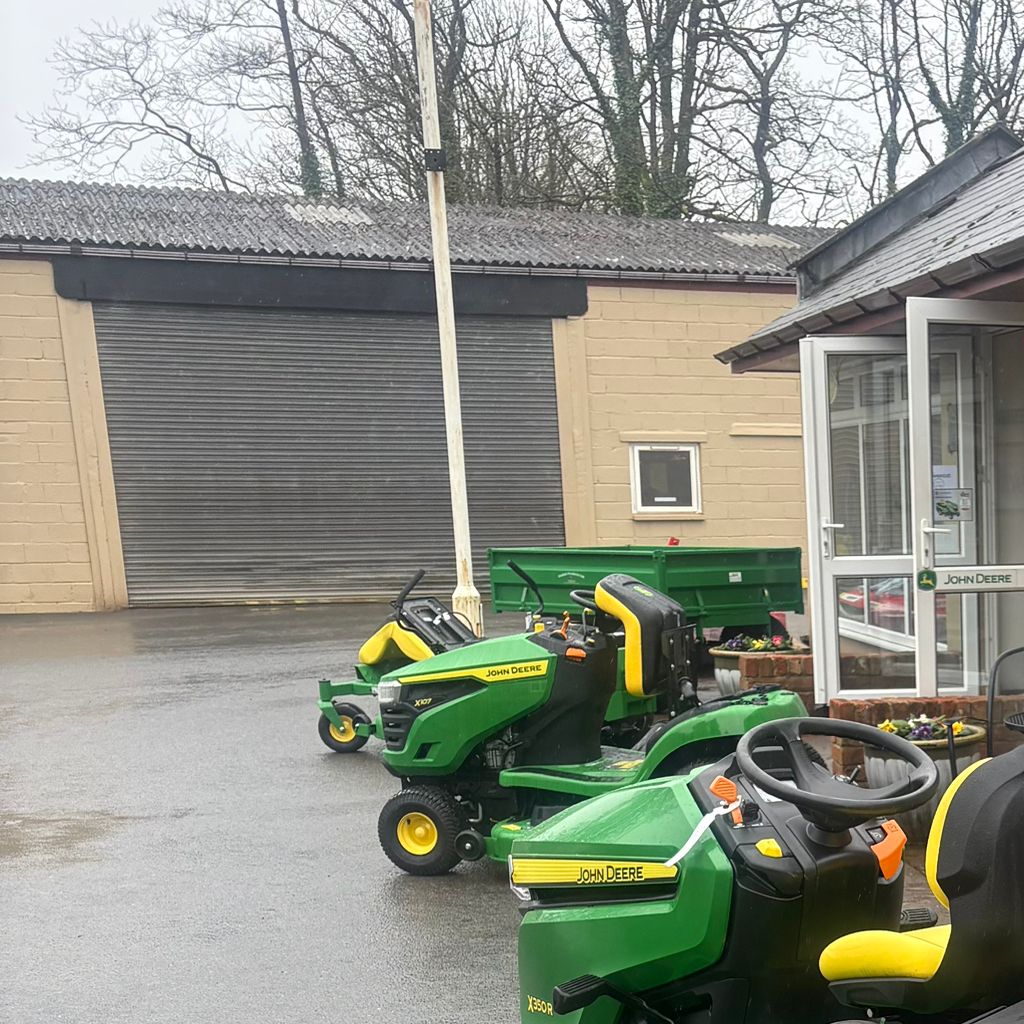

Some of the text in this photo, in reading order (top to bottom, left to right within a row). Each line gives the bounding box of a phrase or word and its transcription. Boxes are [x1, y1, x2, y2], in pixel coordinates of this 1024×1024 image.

[944, 573, 1012, 584] JOHN DEERE
[486, 664, 542, 678] JOHN DEERE
[577, 865, 643, 884] JOHN DEERE
